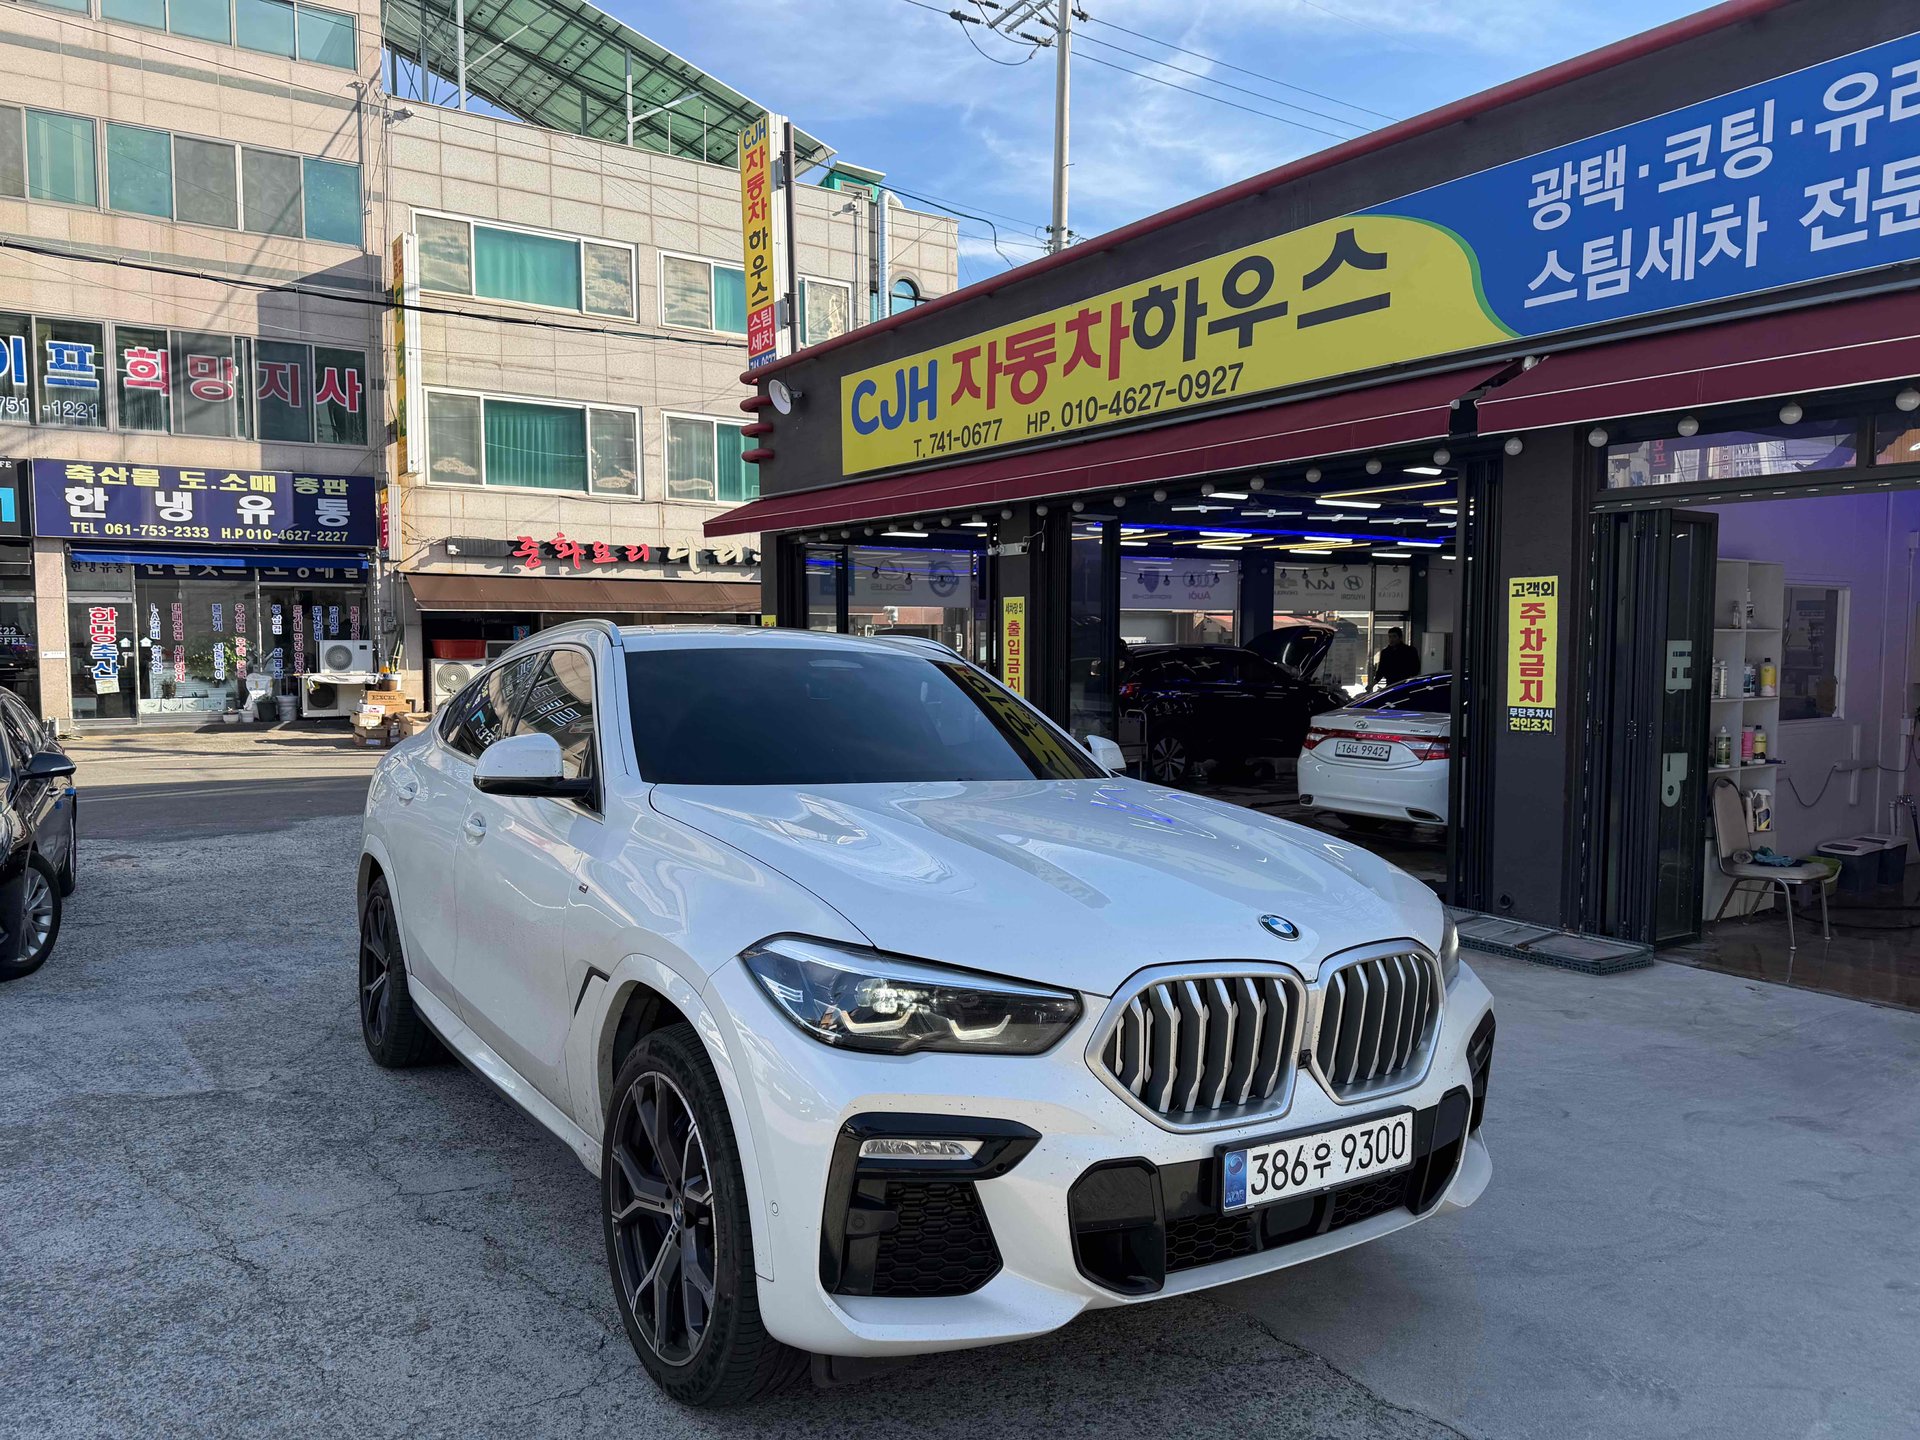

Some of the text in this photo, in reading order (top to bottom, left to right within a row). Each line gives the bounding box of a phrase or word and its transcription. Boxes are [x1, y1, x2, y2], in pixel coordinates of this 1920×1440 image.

[743, 119, 767, 150] CJH
[1524, 196, 1768, 309] 스팀세차
[750, 306, 772, 332] 스팀
[751, 328, 774, 351] 세차
[123, 346, 363, 413] 희망지사
[851, 358, 938, 436] CJH
[928, 417, 1003, 455] 741-0677
[1060, 361, 1244, 429] 010-4627-0927
[65, 464, 161, 488] 축산물
[293, 477, 349, 496] 총판
[70, 521, 99, 535] TEL
[104, 523, 210, 539] 061-753-2333
[246, 528, 349, 543] 010-4627-2227
[512, 531, 761, 574] 중화요리 다리
[1511, 580, 1555, 598] 고객외
[89, 606, 118, 680] 한냉축산
[1006, 619, 1021, 693] 출입금지
[1519, 601, 1547, 703] 주차금지
[1509, 717, 1553, 733] 견인조치
[1361, 745, 1385, 757] 9942
[1250, 1121, 1406, 1196] 386우 9300
